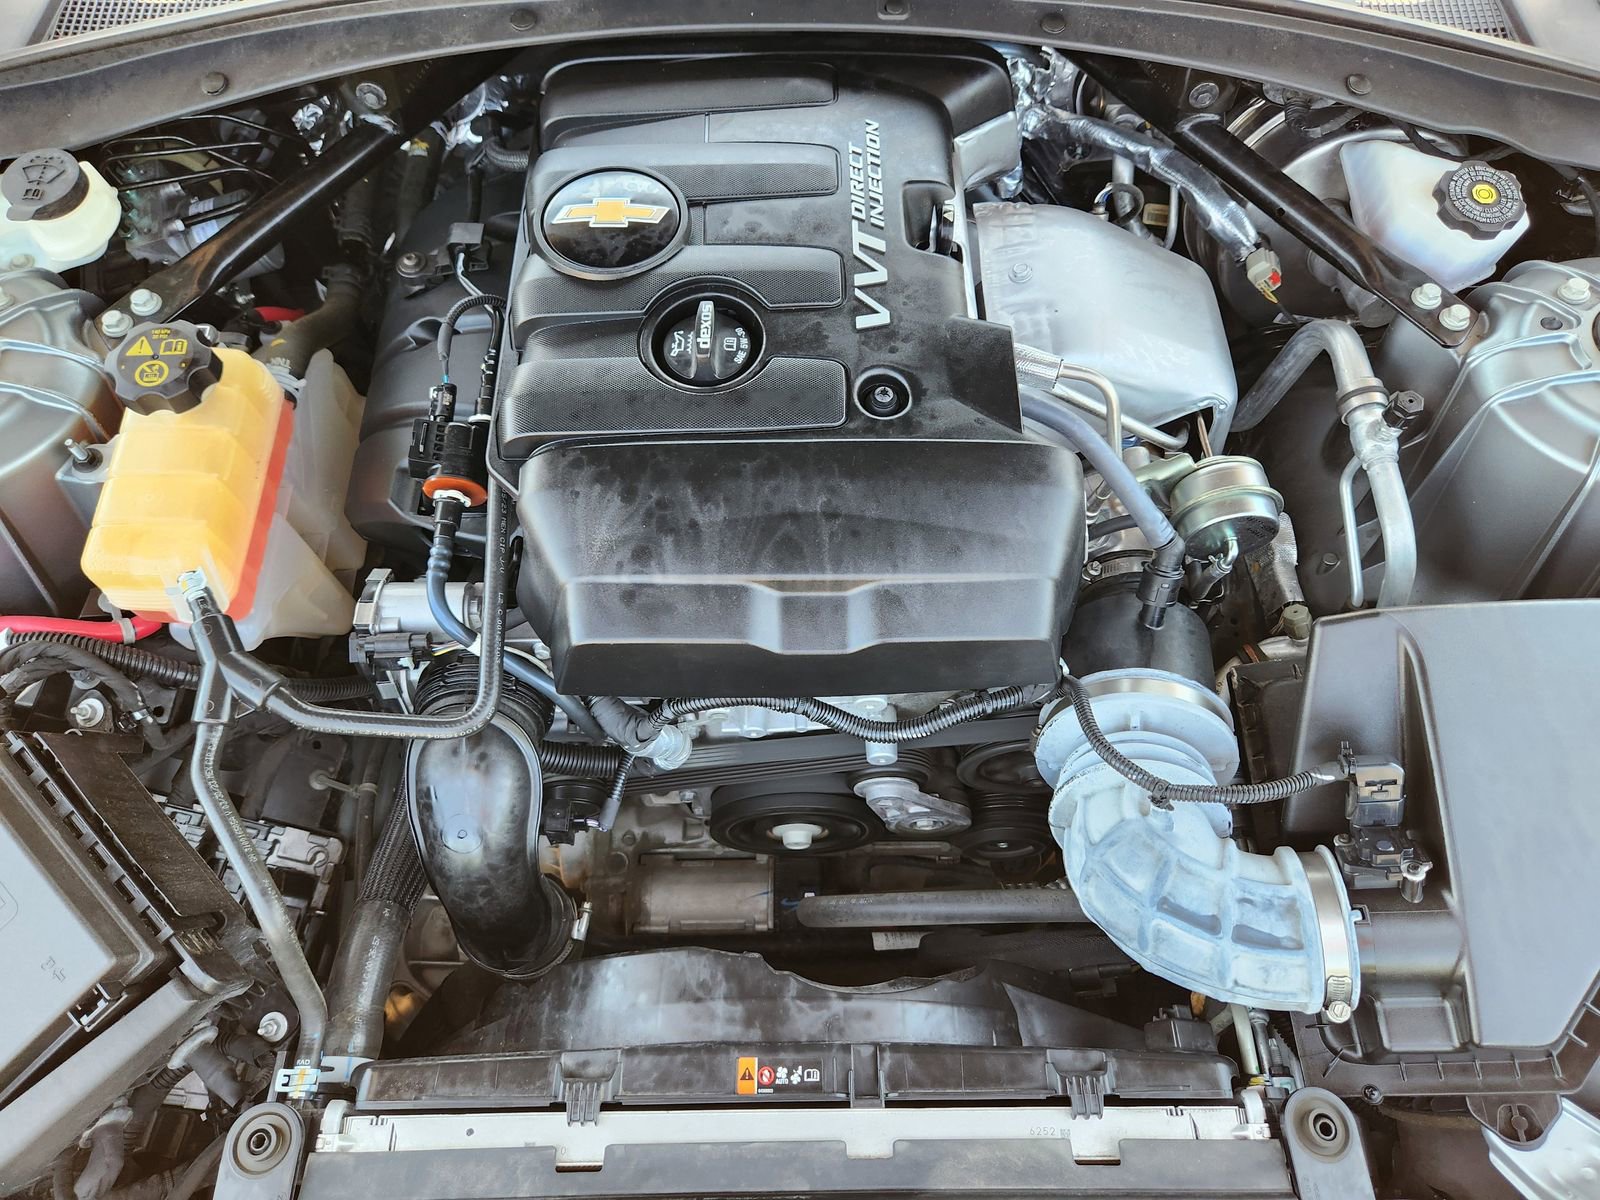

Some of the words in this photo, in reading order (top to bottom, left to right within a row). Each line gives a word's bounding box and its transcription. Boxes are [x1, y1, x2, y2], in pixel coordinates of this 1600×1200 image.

[849, 142, 866, 220] DIRECT
[865, 119, 885, 229] INJECTION
[852, 218, 891, 330] VVT
[697, 304, 712, 348] dexos
[1030, 1126, 1056, 1136] 6252
